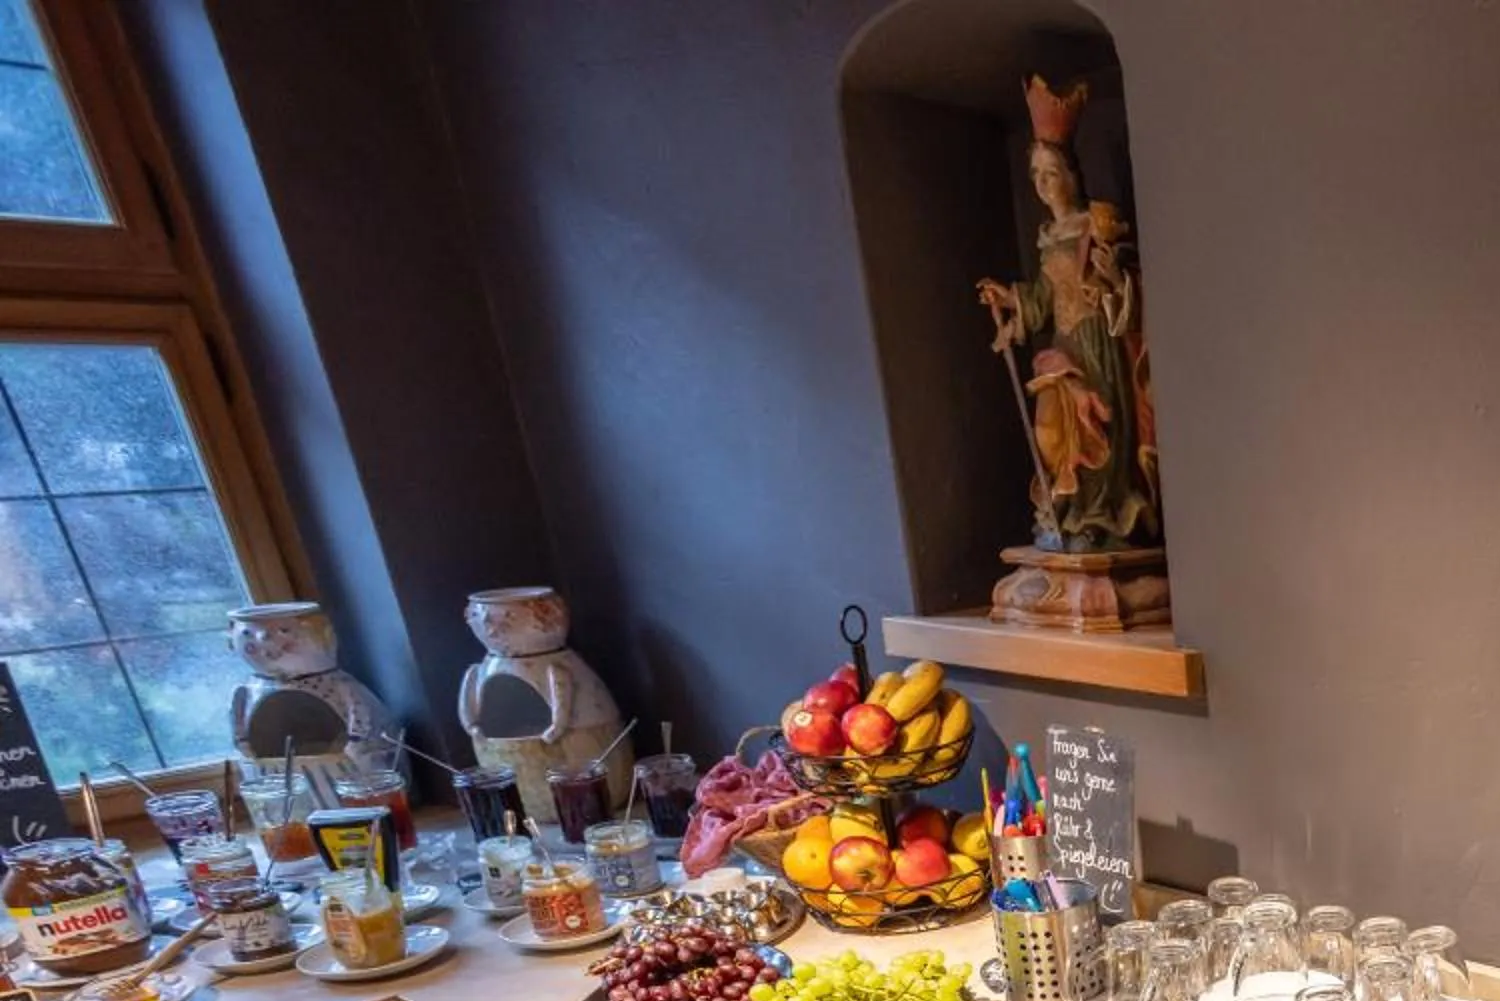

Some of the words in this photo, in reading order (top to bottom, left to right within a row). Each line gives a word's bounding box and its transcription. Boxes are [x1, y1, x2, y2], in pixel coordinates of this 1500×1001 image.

[1052, 734, 1092, 768] Fragen
[1097, 738, 1118, 764] Sie
[1054, 766, 1079, 785] uns
[1083, 773, 1117, 801] gerne
[36, 904, 128, 937] nutella
